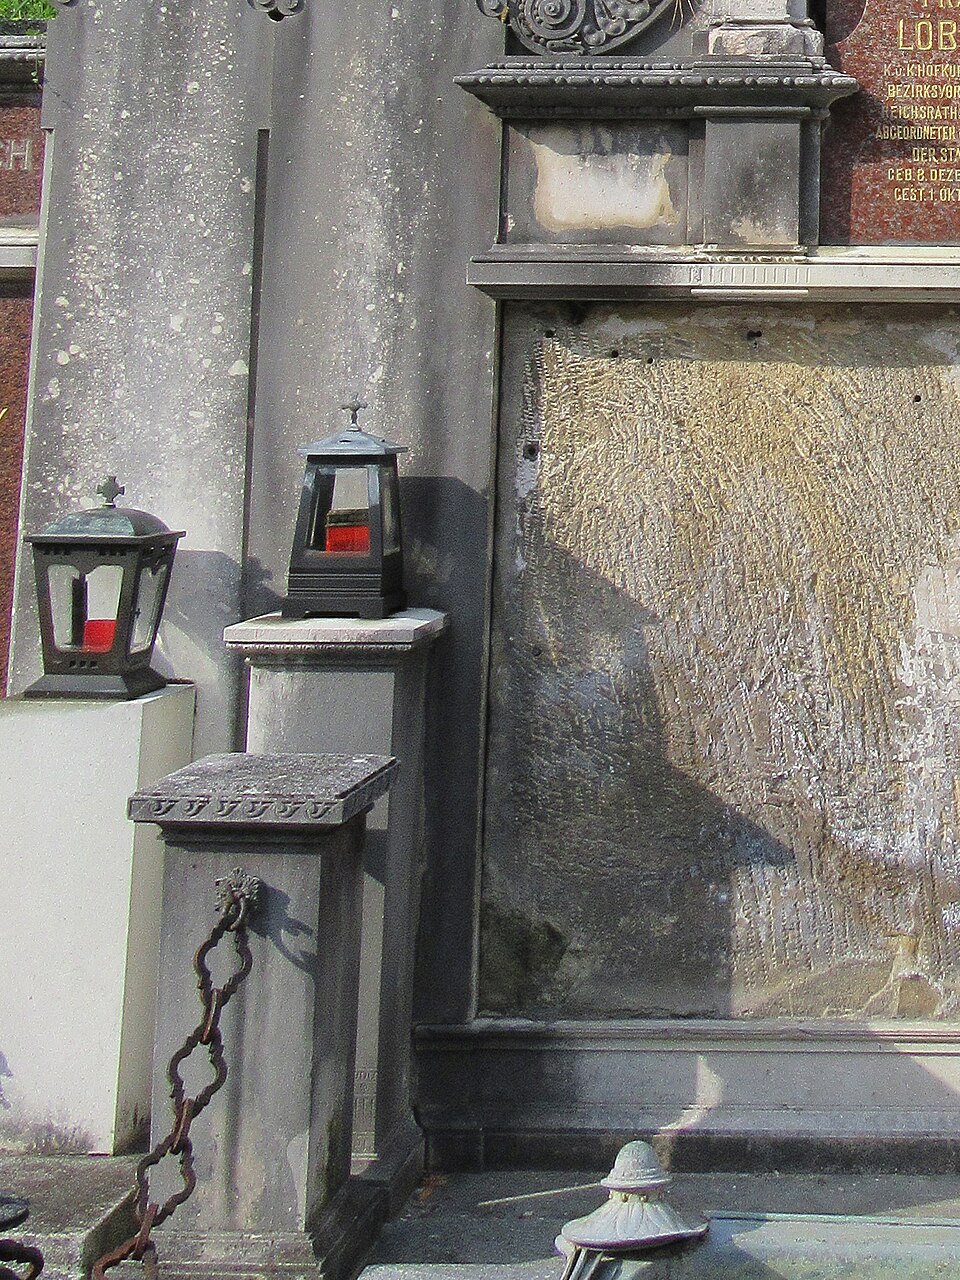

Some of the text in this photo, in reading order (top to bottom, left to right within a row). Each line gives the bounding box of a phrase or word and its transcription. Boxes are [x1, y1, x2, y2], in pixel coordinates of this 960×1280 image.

[875, 125, 956, 141] ABGEORDNETER
[912, 147, 938, 162] DER
[888, 167, 915, 181] GEB.
[894, 187, 927, 202] GEST.
